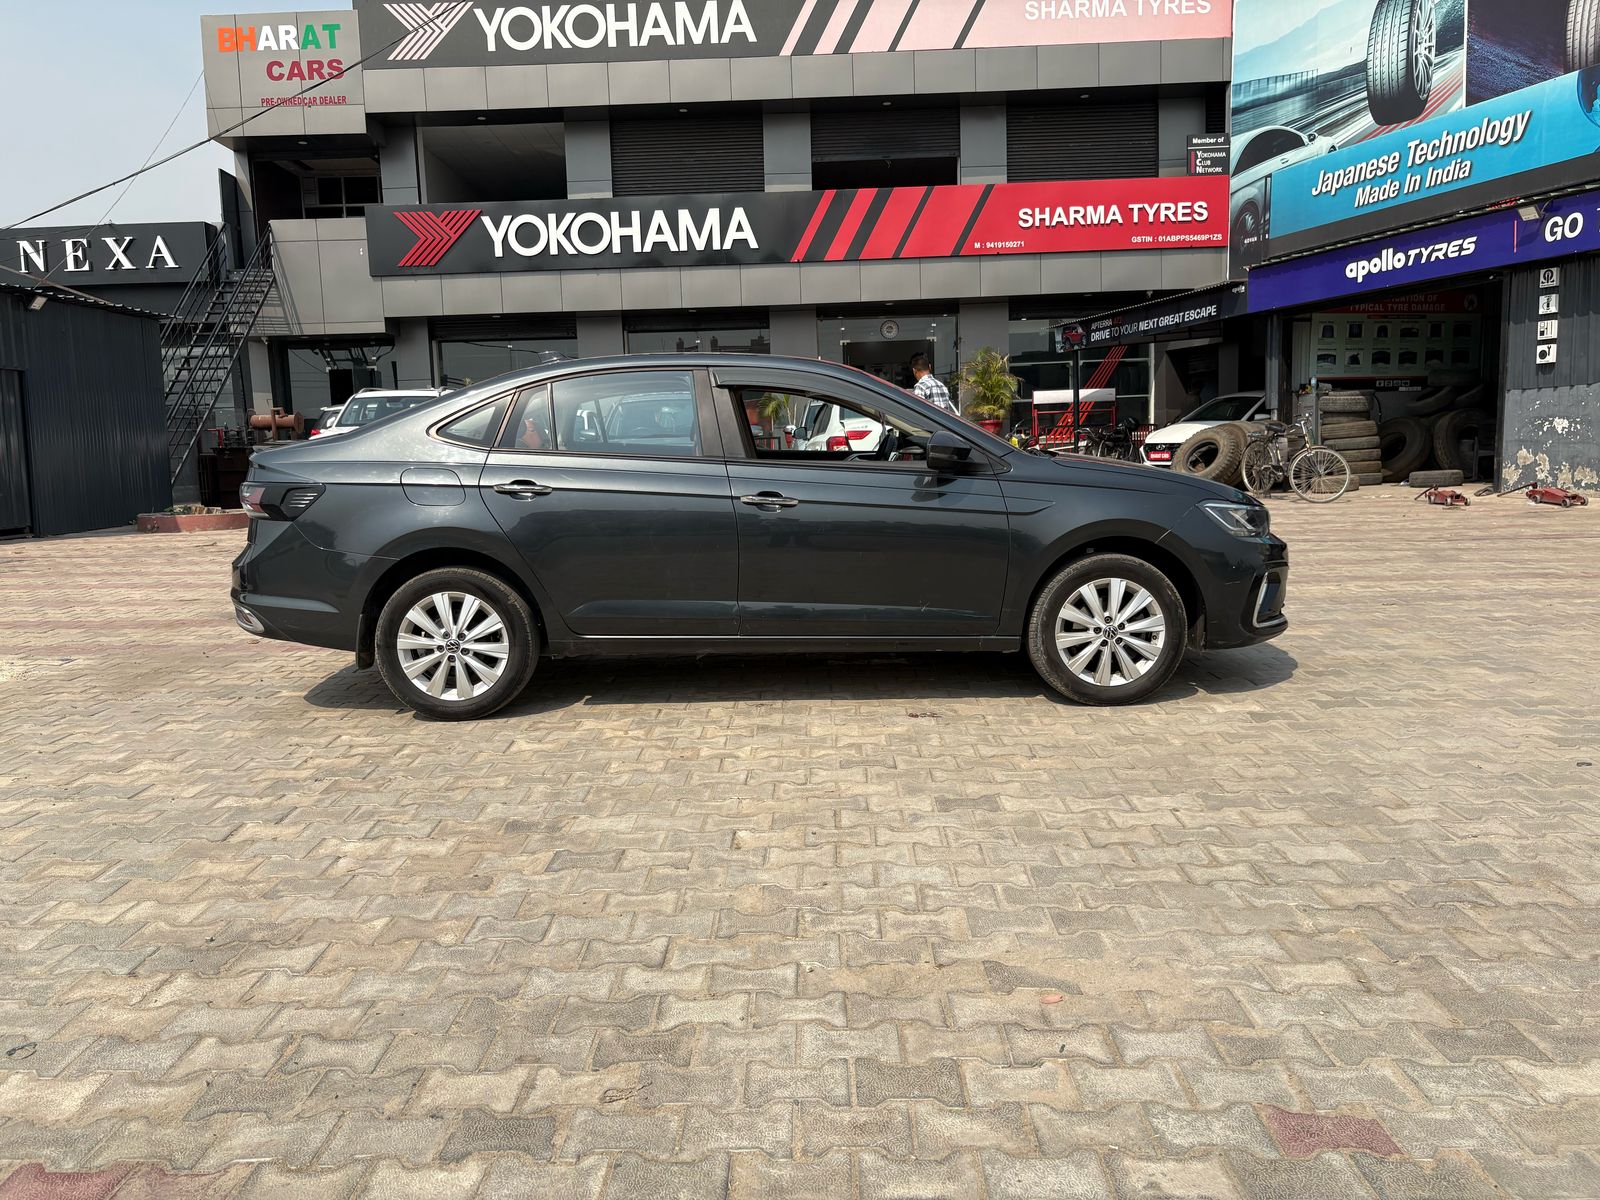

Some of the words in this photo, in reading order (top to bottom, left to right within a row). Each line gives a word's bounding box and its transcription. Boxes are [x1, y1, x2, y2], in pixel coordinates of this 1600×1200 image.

[1024, 0, 1128, 21] SHARMA
[1137, 0, 1212, 17] TYRES
[217, 23, 341, 53] BHARAT
[473, 0, 758, 52] YOKOHAMA
[266, 58, 345, 82] CARS
[260, 97, 302, 107] PRE-OWNED
[302, 96, 318, 106] CAR
[319, 95, 347, 105] DEALER
[1312, 150, 1400, 197] Japanese
[1406, 108, 1532, 168] Technology
[1354, 178, 1400, 208] Made
[1403, 172, 1421, 194] In
[1425, 159, 1472, 189] India
[1018, 204, 1124, 229] SHARMA
[1128, 201, 1209, 224] TYRES
[1544, 212, 1584, 243] GO
[480, 206, 759, 258] YOKOHAMA
[986, 240, 1025, 249] 9419150271
[16, 235, 180, 274] NEXA
[1387, 303, 1408, 311] TYRE
[1411, 303, 1445, 311] DAMAGE
[1091, 328, 1110, 342] DRIVE
[1111, 326, 1120, 338] TO
[1120, 322, 1138, 336] YOUR
[1138, 317, 1158, 331] NEXT
[1158, 314, 1183, 328] GREAT
[1184, 305, 1217, 322] ESCAPE
